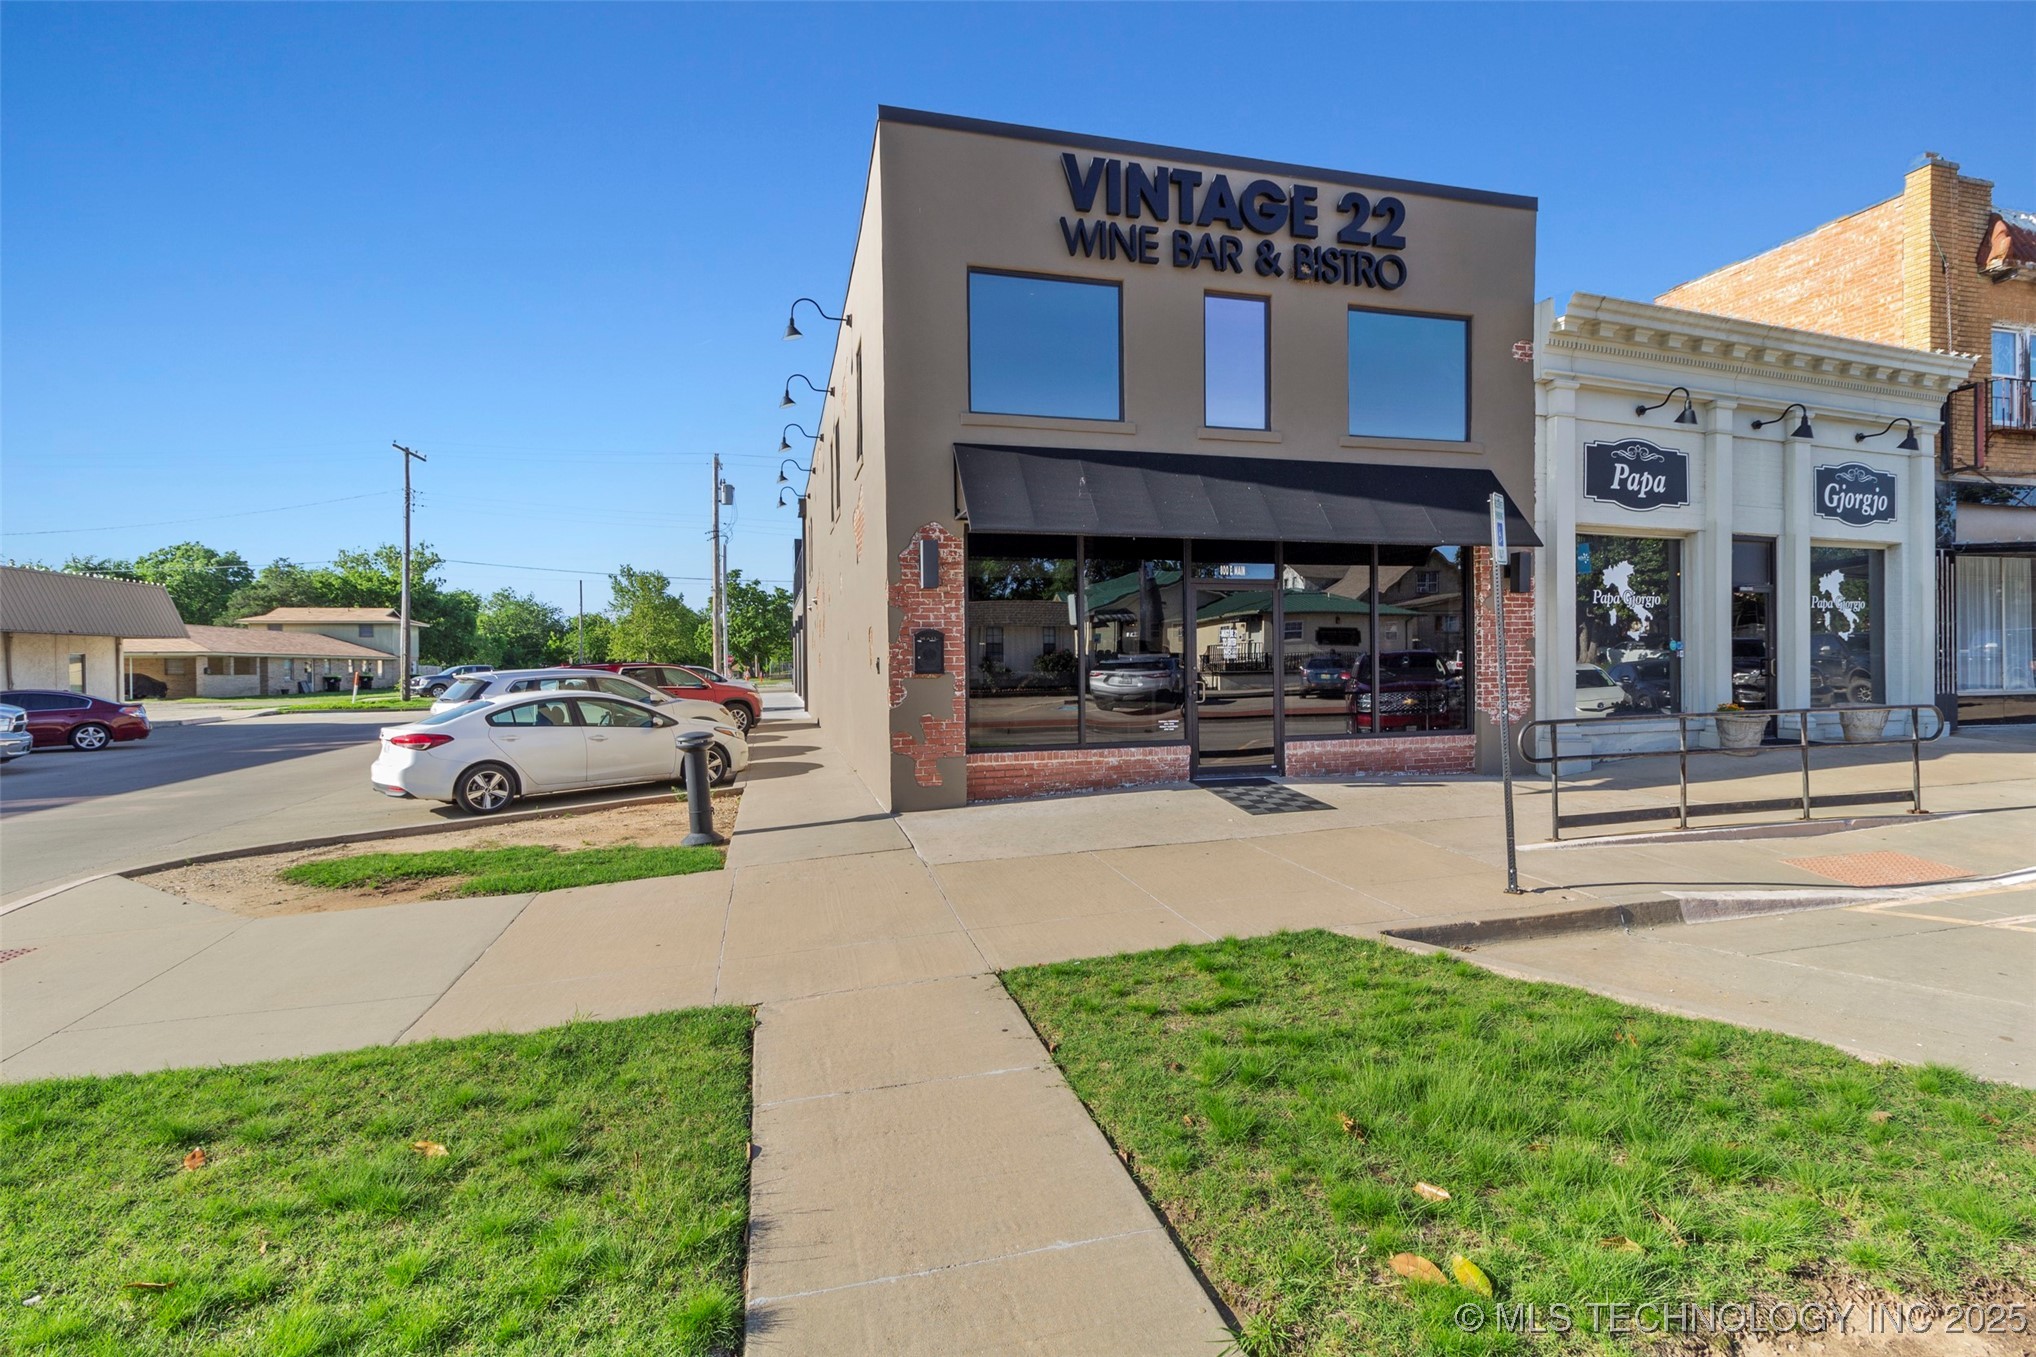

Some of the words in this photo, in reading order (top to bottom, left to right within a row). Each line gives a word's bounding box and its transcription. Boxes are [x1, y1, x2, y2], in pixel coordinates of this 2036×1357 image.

[1060, 152, 1318, 239] VINTAGE
[1336, 192, 1406, 250] 22
[1059, 216, 1160, 265] WINE
[1172, 229, 1243, 274] BAR
[1254, 239, 1284, 277] &
[1292, 243, 1407, 290] BISTRO
[1610, 463, 1666, 498] Papa
[1824, 483, 1888, 516] Gjorgjo
[1592, 589, 1620, 607] Papa
[1622, 590, 1661, 608] Gjorgjo
[1811, 595, 1833, 612] Papa
